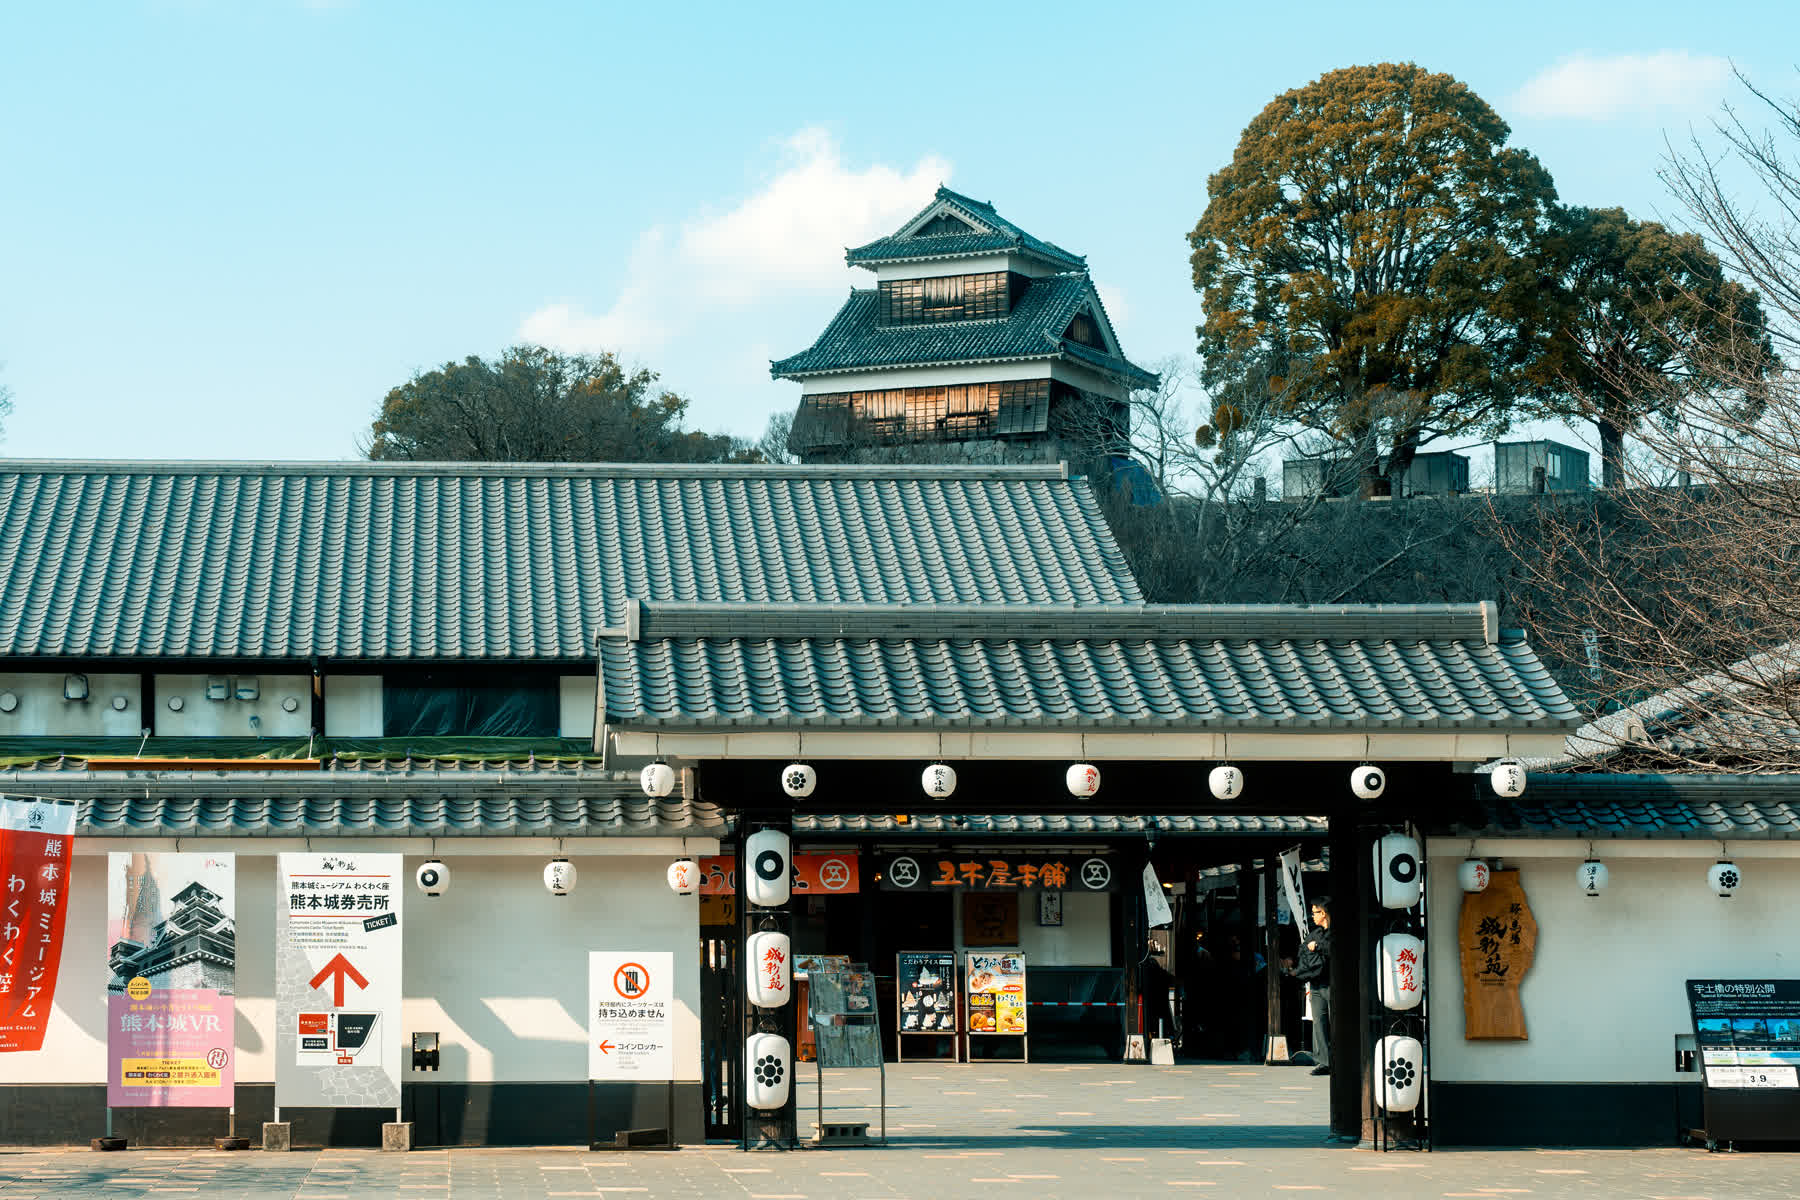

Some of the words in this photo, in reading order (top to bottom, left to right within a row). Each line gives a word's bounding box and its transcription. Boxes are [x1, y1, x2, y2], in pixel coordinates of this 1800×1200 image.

[931, 860, 1070, 888] 五木屋本舗
[291, 881, 352, 890] 熊本城ミュージアム
[354, 881, 390, 890] わくわく座
[289, 893, 390, 910] 熊本城券売所
[22, 839, 62, 1017] 熊本城ミュージアム
[365, 917, 390, 929] TICKET
[1470, 916, 1509, 977] 城彩苑
[761, 946, 785, 991] 城彩苑
[1391, 947, 1418, 992] 城彩苑
[1693, 983, 1776, 994] 宇土櫓の特別公開
[598, 1008, 665, 1018] 持ち込めません
[120, 1013, 223, 1032] 熊本城VR
[617, 1043, 664, 1051] コインロッカー
[1759, 1074, 1767, 1083] 9
